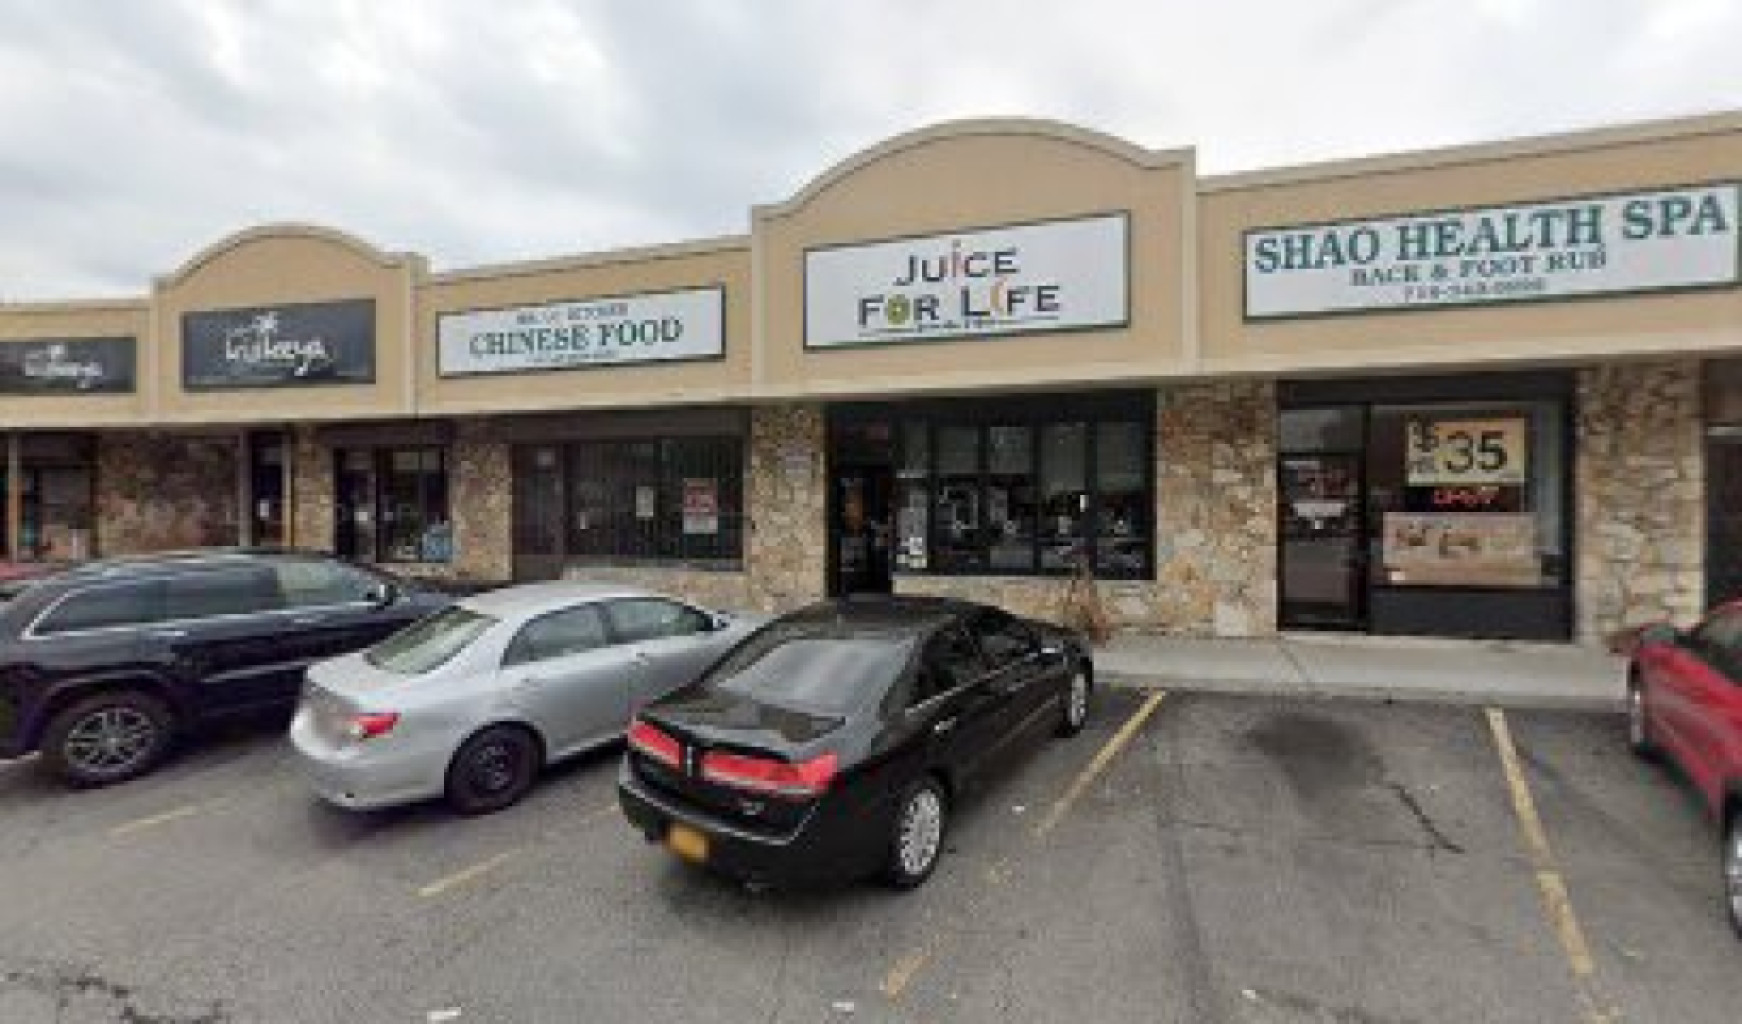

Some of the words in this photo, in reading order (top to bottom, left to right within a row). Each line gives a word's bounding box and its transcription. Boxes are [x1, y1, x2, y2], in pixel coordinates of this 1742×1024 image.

[1254, 227, 1381, 273] SHAO
[1395, 205, 1604, 261] HEALTH
[1621, 195, 1728, 240] SPA
[1458, 255, 1536, 279] FOOT
[858, 293, 940, 326] FOR
[469, 325, 590, 356] CHINESE
[600, 316, 684, 346] FOOD
